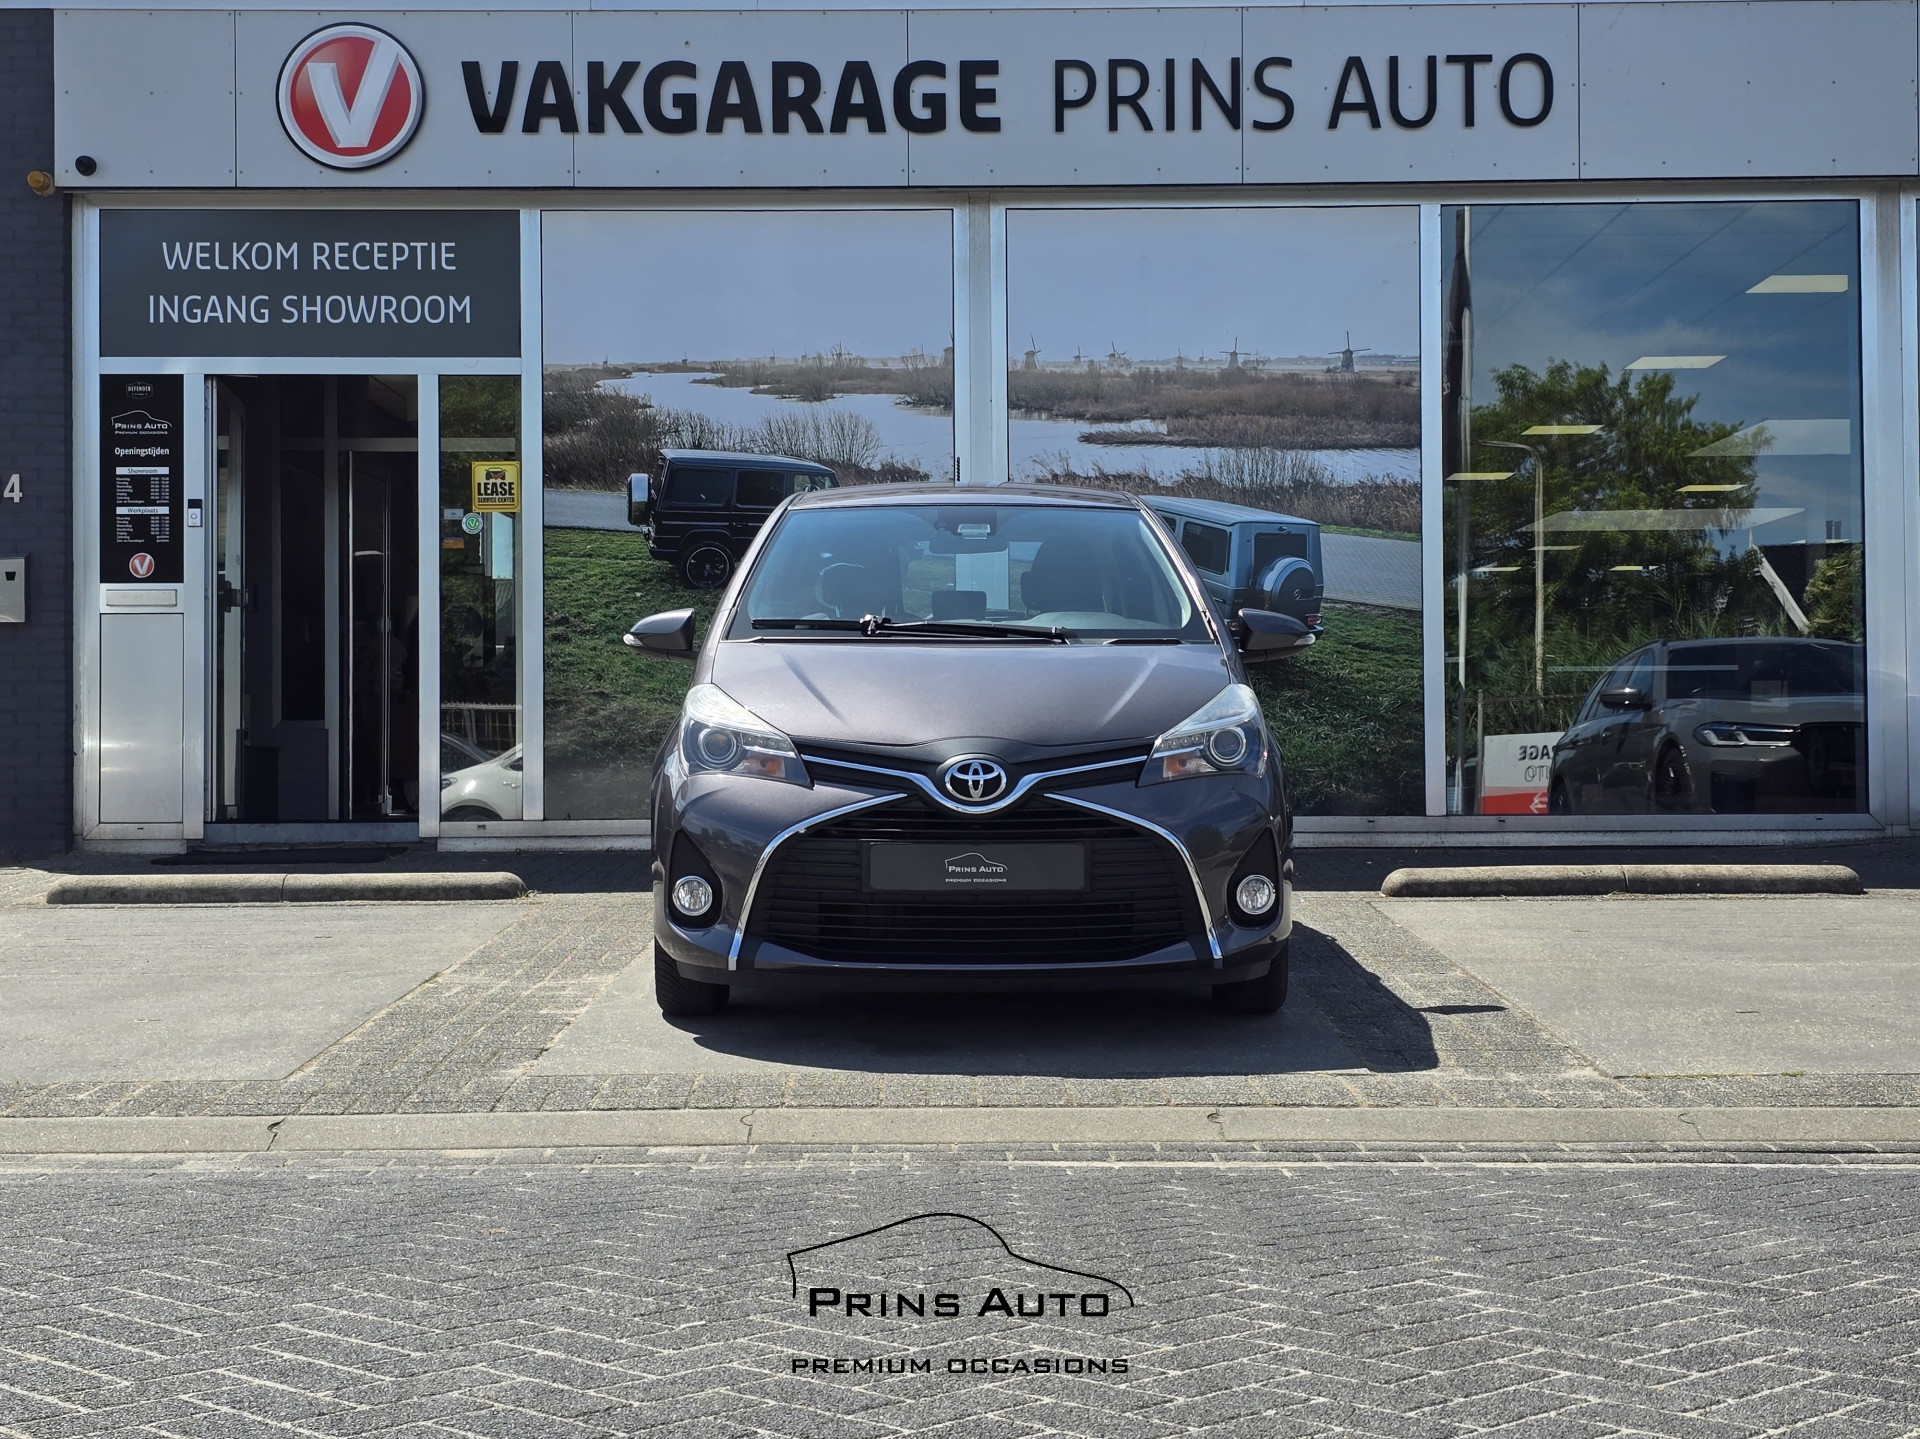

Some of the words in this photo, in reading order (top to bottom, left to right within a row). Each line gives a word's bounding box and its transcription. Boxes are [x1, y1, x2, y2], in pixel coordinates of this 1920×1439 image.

[461, 59, 1001, 135] VAKGARAGE
[1055, 56, 1294, 133] PRINS
[1328, 52, 1554, 129] AUTO
[162, 241, 298, 271] WELKOM
[313, 241, 457, 271] RECEPTIE
[148, 294, 270, 324] INGANG
[281, 295, 471, 324] SHOWROOM
[114, 447, 170, 457] Openingstijden
[3, 473, 23, 503] 4
[477, 482, 515, 496] LEASE
